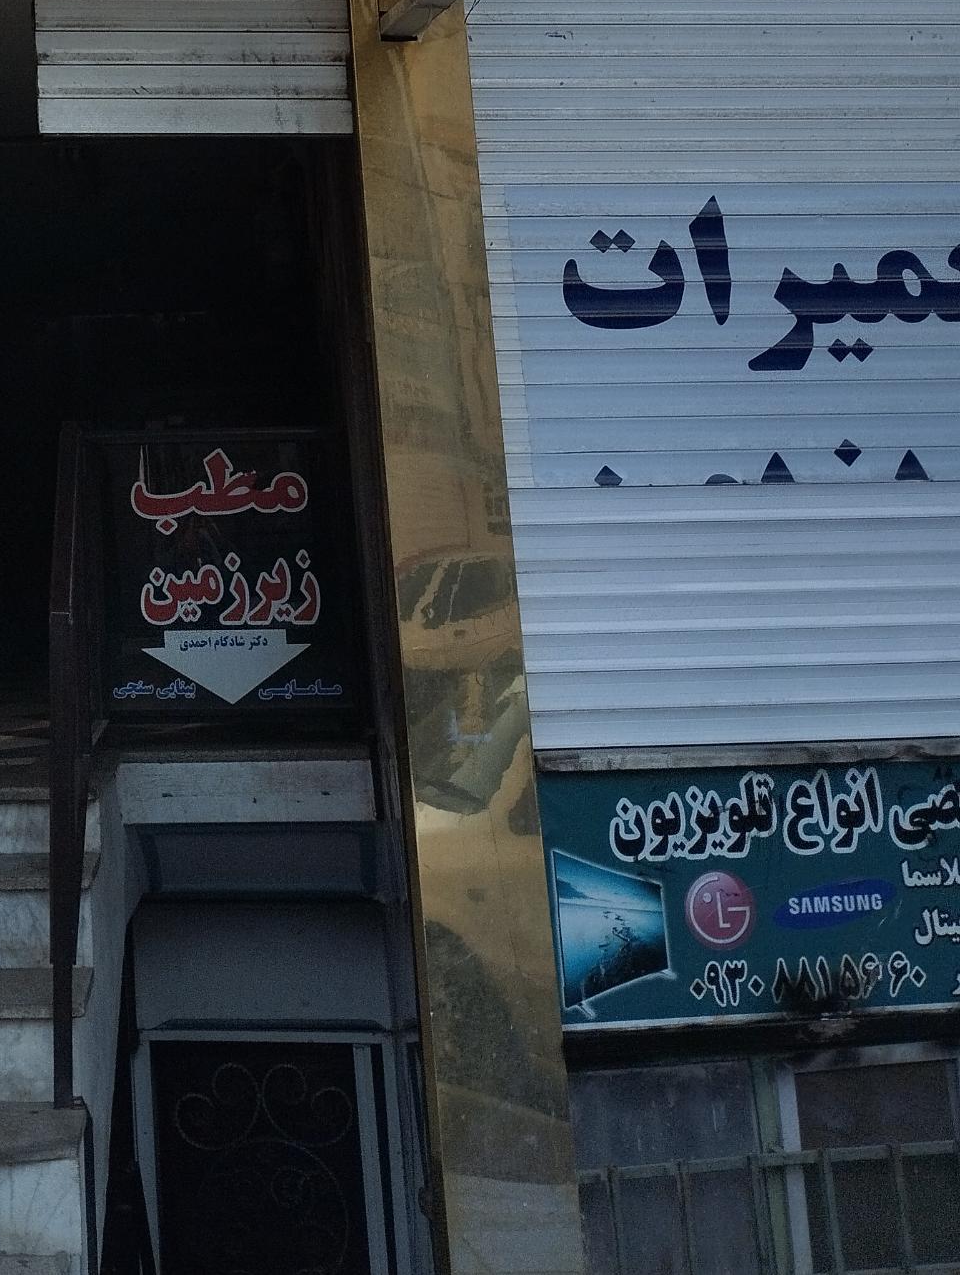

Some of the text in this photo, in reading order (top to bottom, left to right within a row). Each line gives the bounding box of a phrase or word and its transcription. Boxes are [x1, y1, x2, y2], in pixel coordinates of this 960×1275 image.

[130, 447, 309, 535] مطب
[179, 635, 212, 652] احمدی
[248, 635, 269, 651] دکتر
[112, 678, 197, 701] بینایی سنجی
[258, 678, 343, 701] مامایی
[609, 771, 778, 862] تلویزیون
[782, 767, 884, 855] انواع
[787, 893, 884, 916] SAMSUNG
